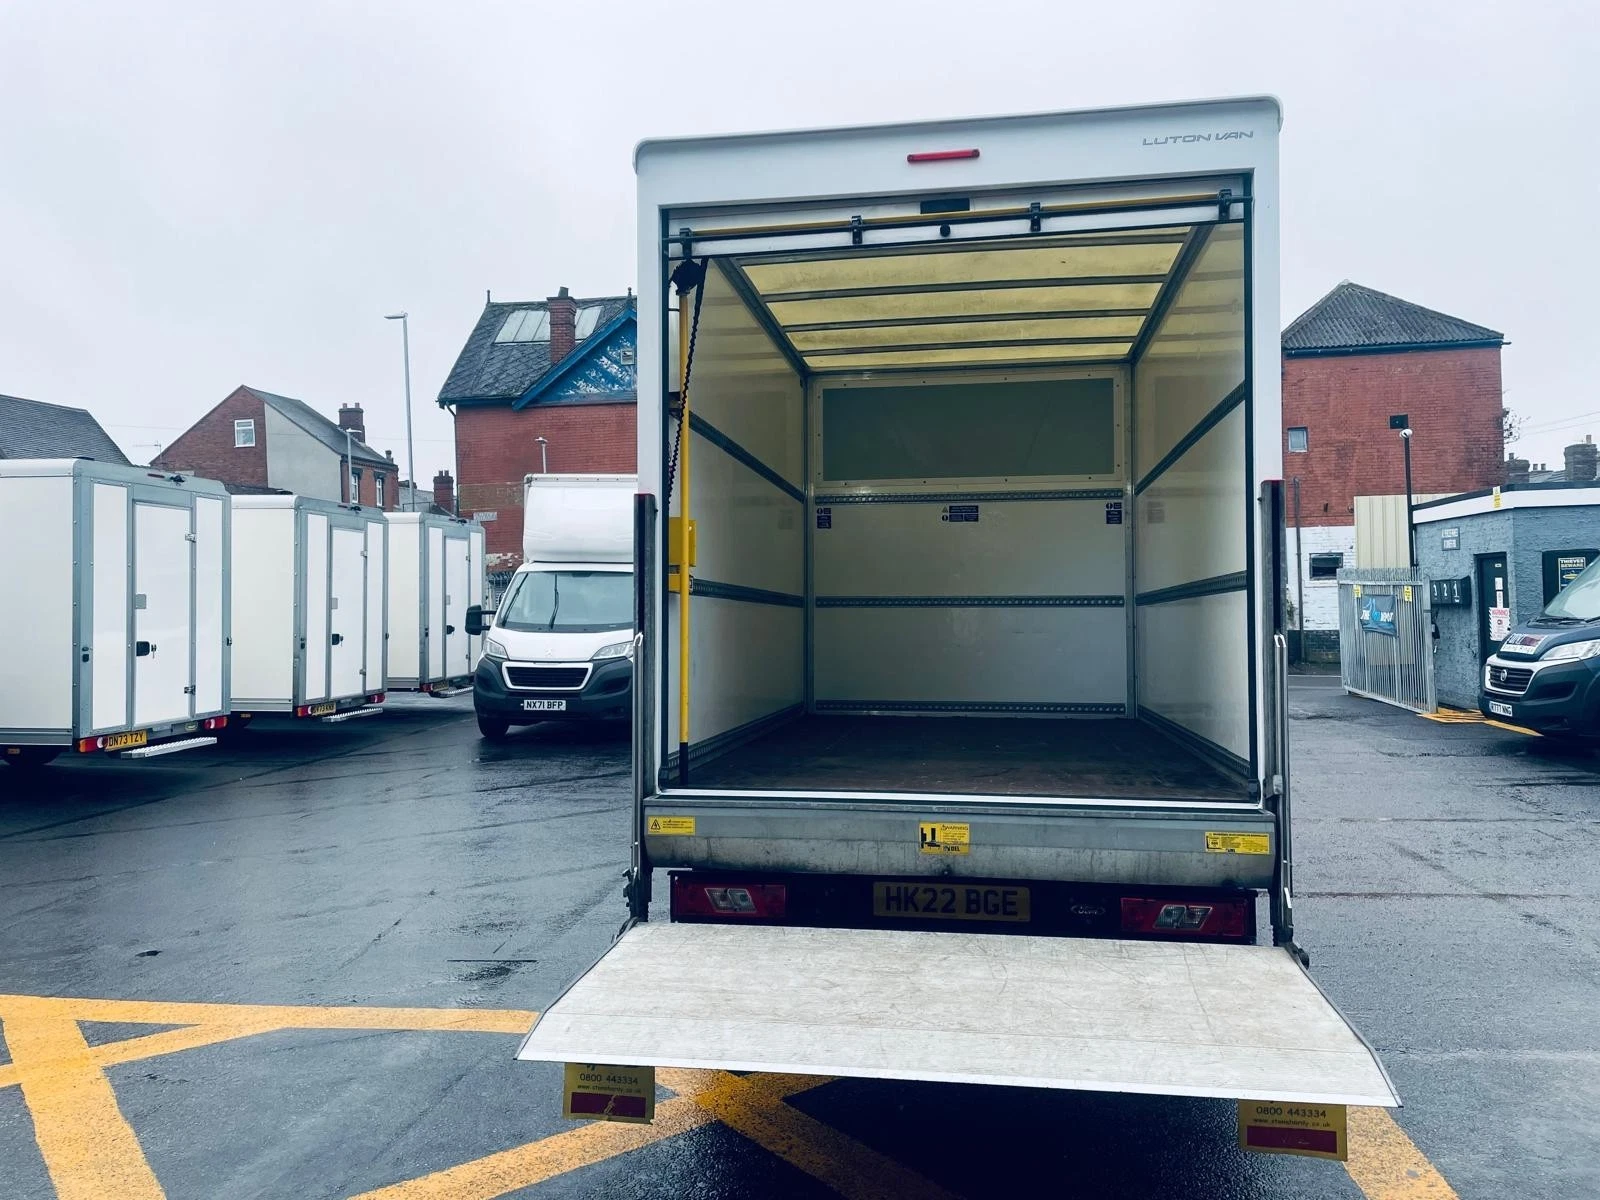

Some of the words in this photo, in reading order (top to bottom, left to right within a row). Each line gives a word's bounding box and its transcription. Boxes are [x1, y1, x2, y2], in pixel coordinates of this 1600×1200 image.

[1142, 133, 1211, 146] LUTON
[1215, 130, 1254, 140] VAN
[526, 700, 545, 710] NX71
[546, 700, 563, 710] BFP
[109, 735, 128, 747] DN73
[129, 732, 144, 744] TZY
[885, 885, 956, 914] HK22
[965, 888, 1019, 918] BGE
[580, 1073, 602, 1082] 0800
[606, 1074, 638, 1085] 443334
[1256, 1106, 1283, 1116] 0800
[1287, 1107, 1327, 1119] 443334
